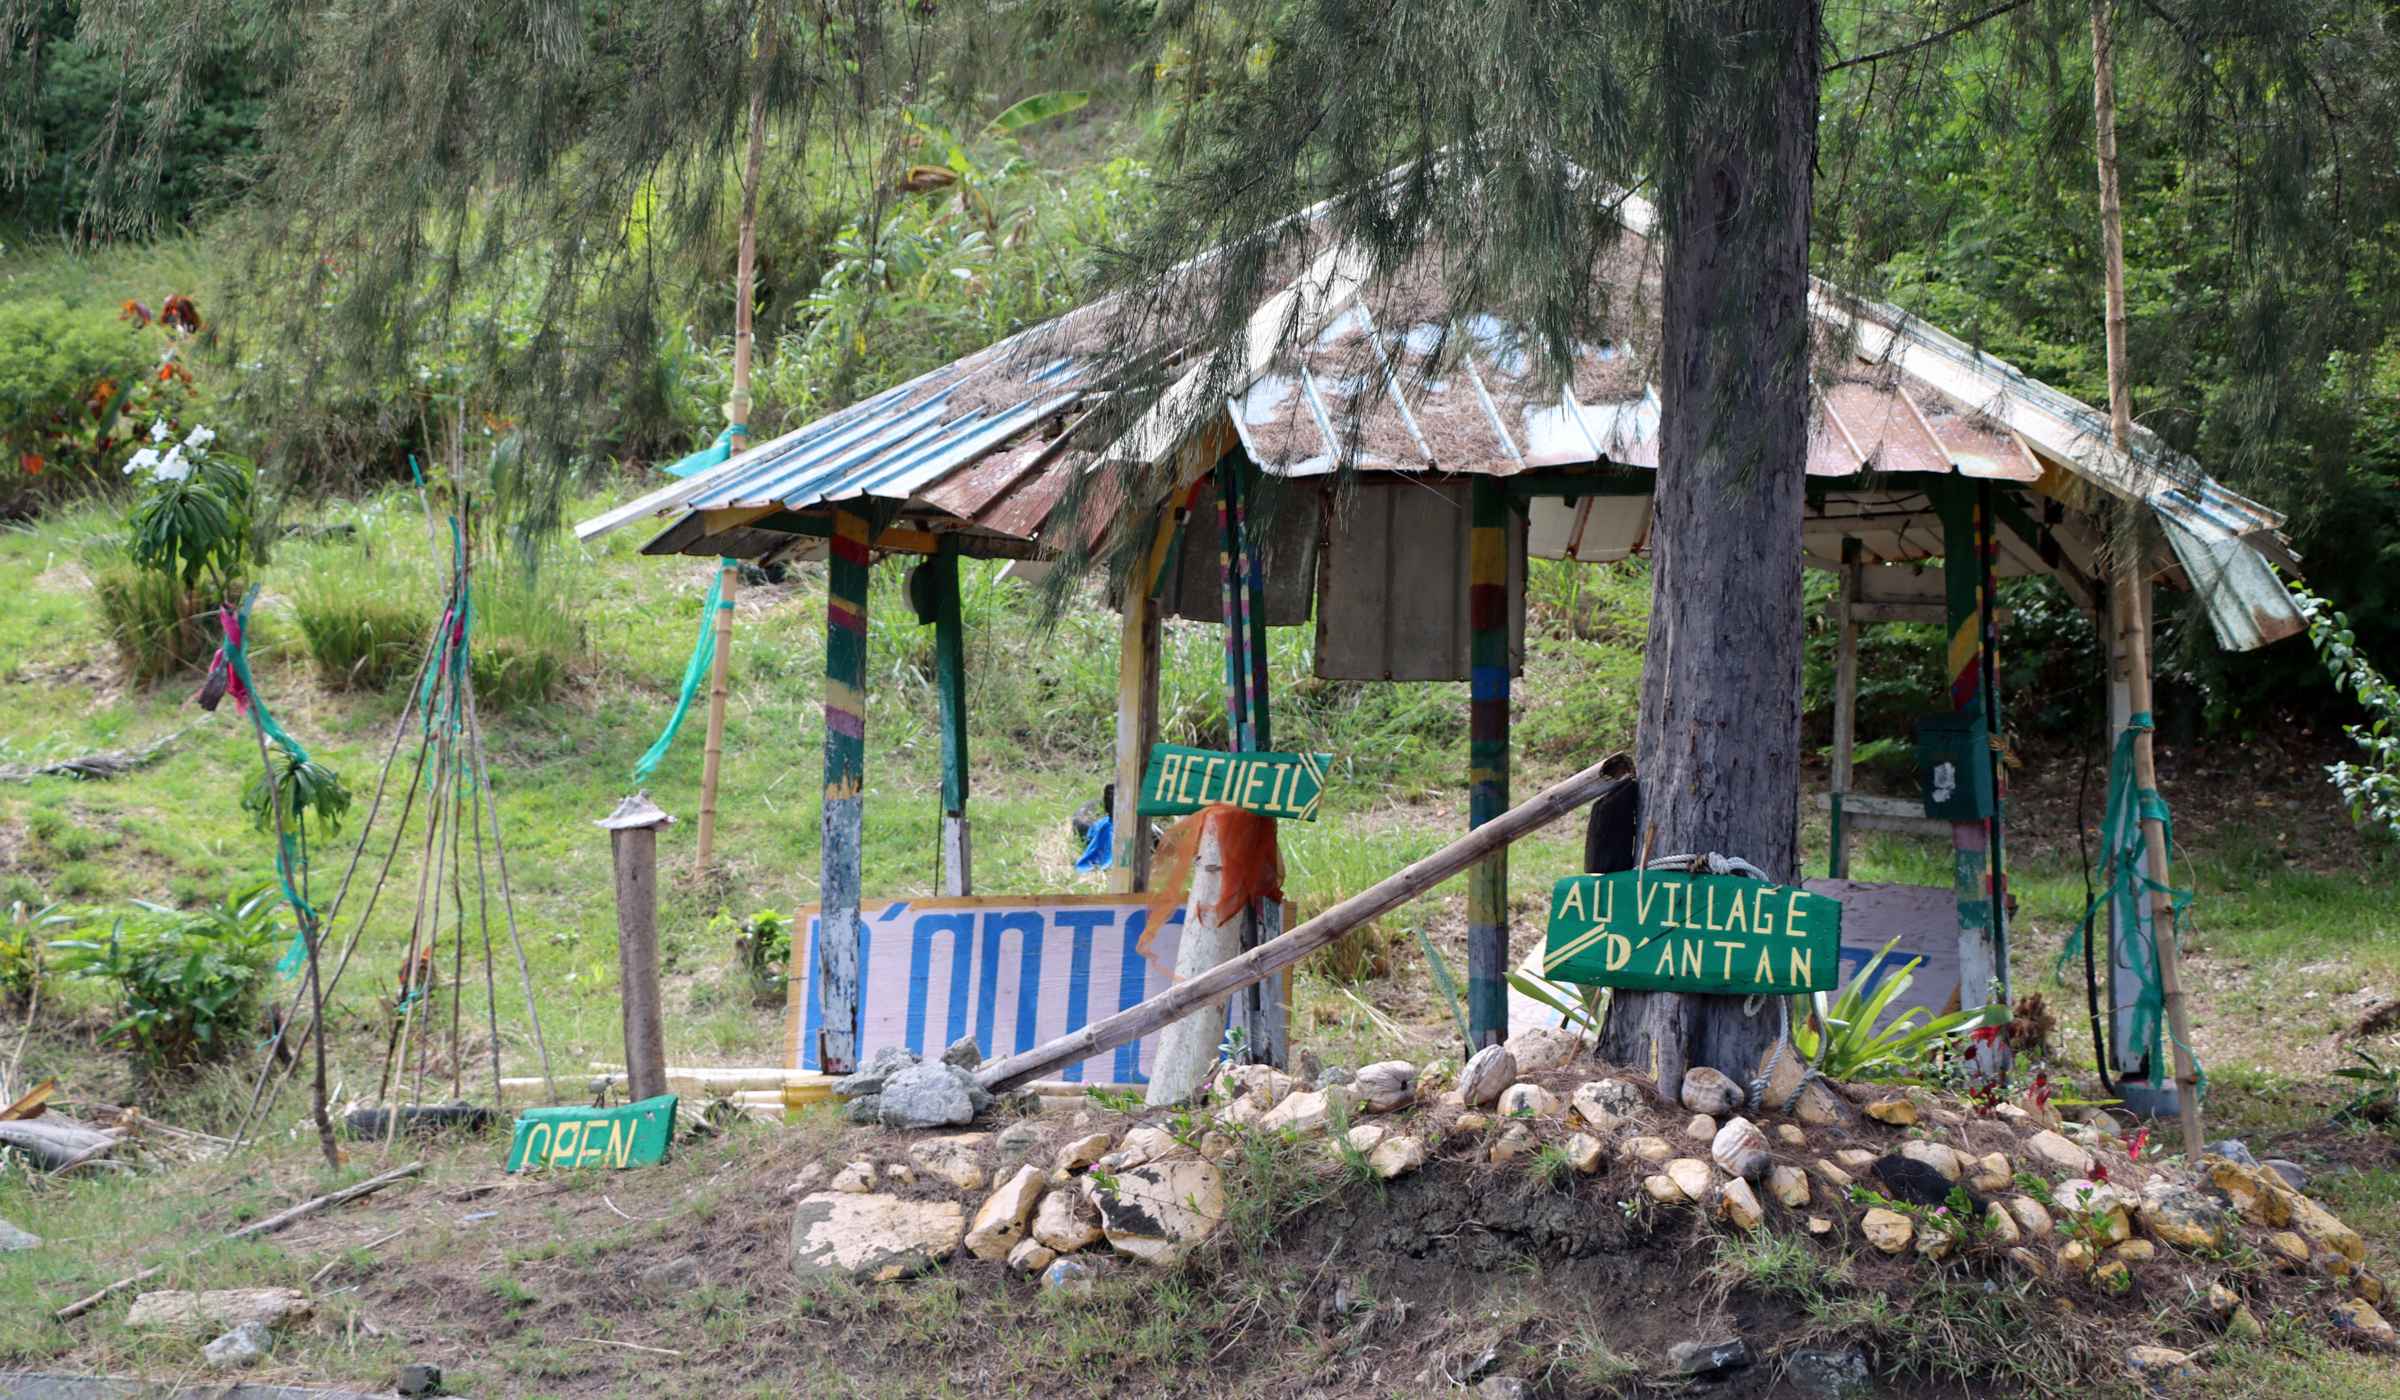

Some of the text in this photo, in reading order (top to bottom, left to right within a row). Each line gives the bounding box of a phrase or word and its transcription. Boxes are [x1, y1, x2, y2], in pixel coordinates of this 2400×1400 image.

[1154, 753, 1304, 813] ACCUEIL
[1557, 879, 1811, 938] AU VILLAGE
[1605, 932, 1813, 989] D'ANTAN
[521, 1118, 639, 1169] OPEN
